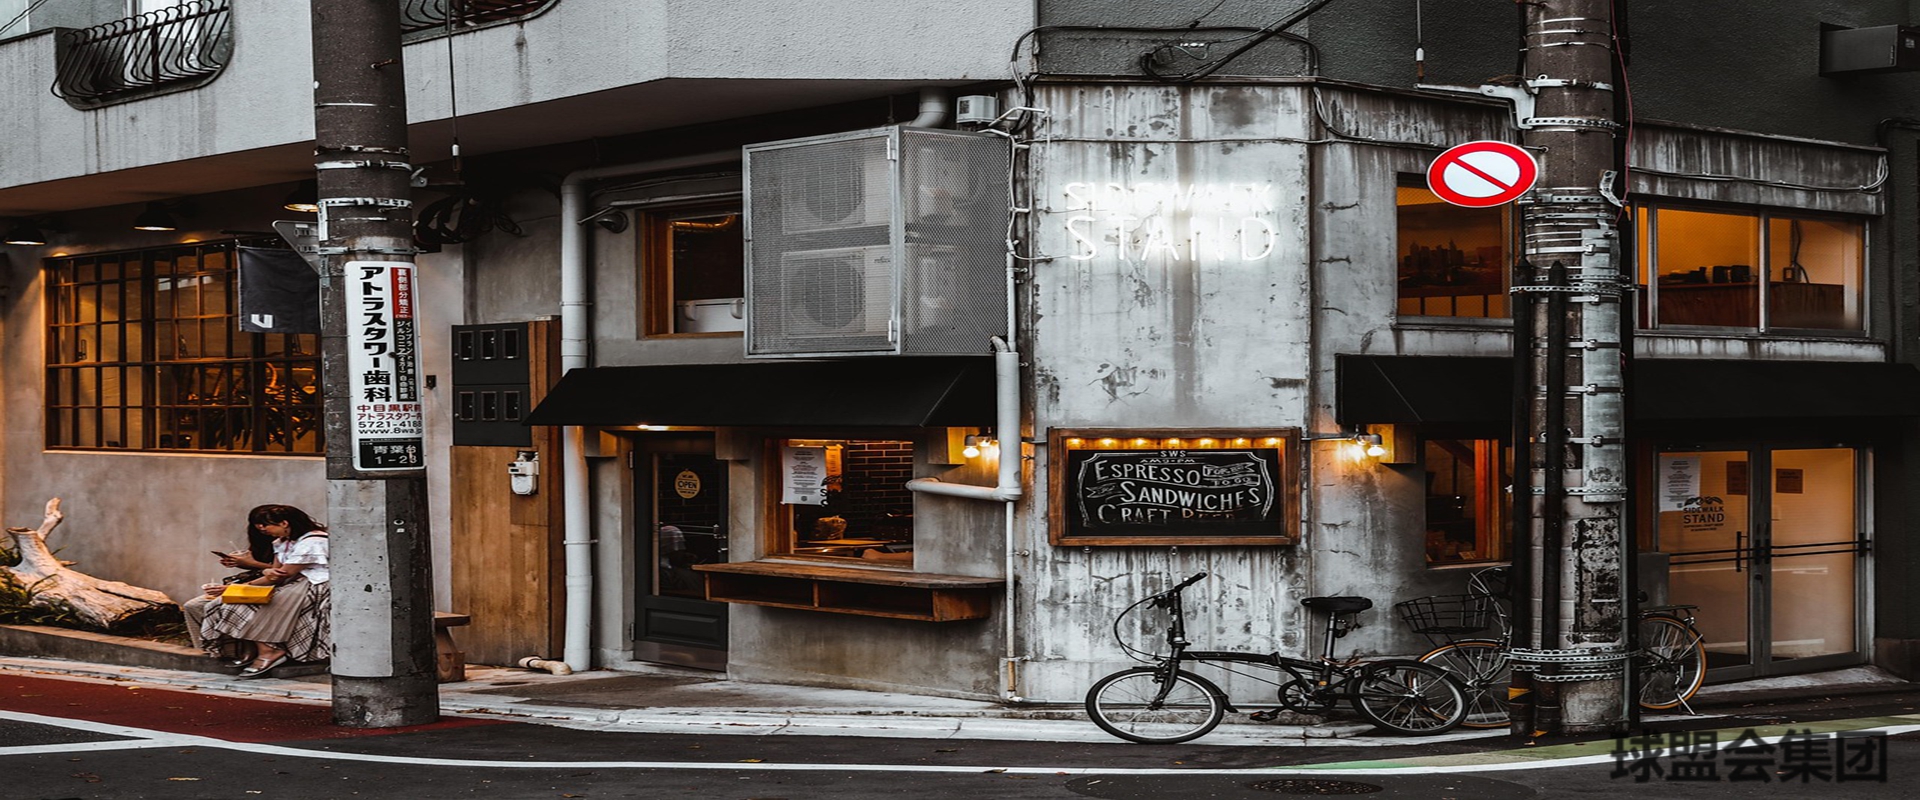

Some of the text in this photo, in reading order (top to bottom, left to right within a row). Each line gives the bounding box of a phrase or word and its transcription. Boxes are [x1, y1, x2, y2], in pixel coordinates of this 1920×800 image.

[1065, 182, 1273, 211] SIDEWK
[1067, 215, 1275, 261] STAND
[360, 267, 392, 402] アトラスタワー歯科
[1160, 450, 1186, 458] SWS
[678, 480, 697, 489] OPEN
[1095, 460, 1201, 486] ESPRESSO
[1120, 481, 1261, 511] SANDWICHES
[1098, 503, 1171, 525] CRAFT
[1683, 506, 1724, 514] SIDEWALK
[1684, 513, 1725, 524] STAND
